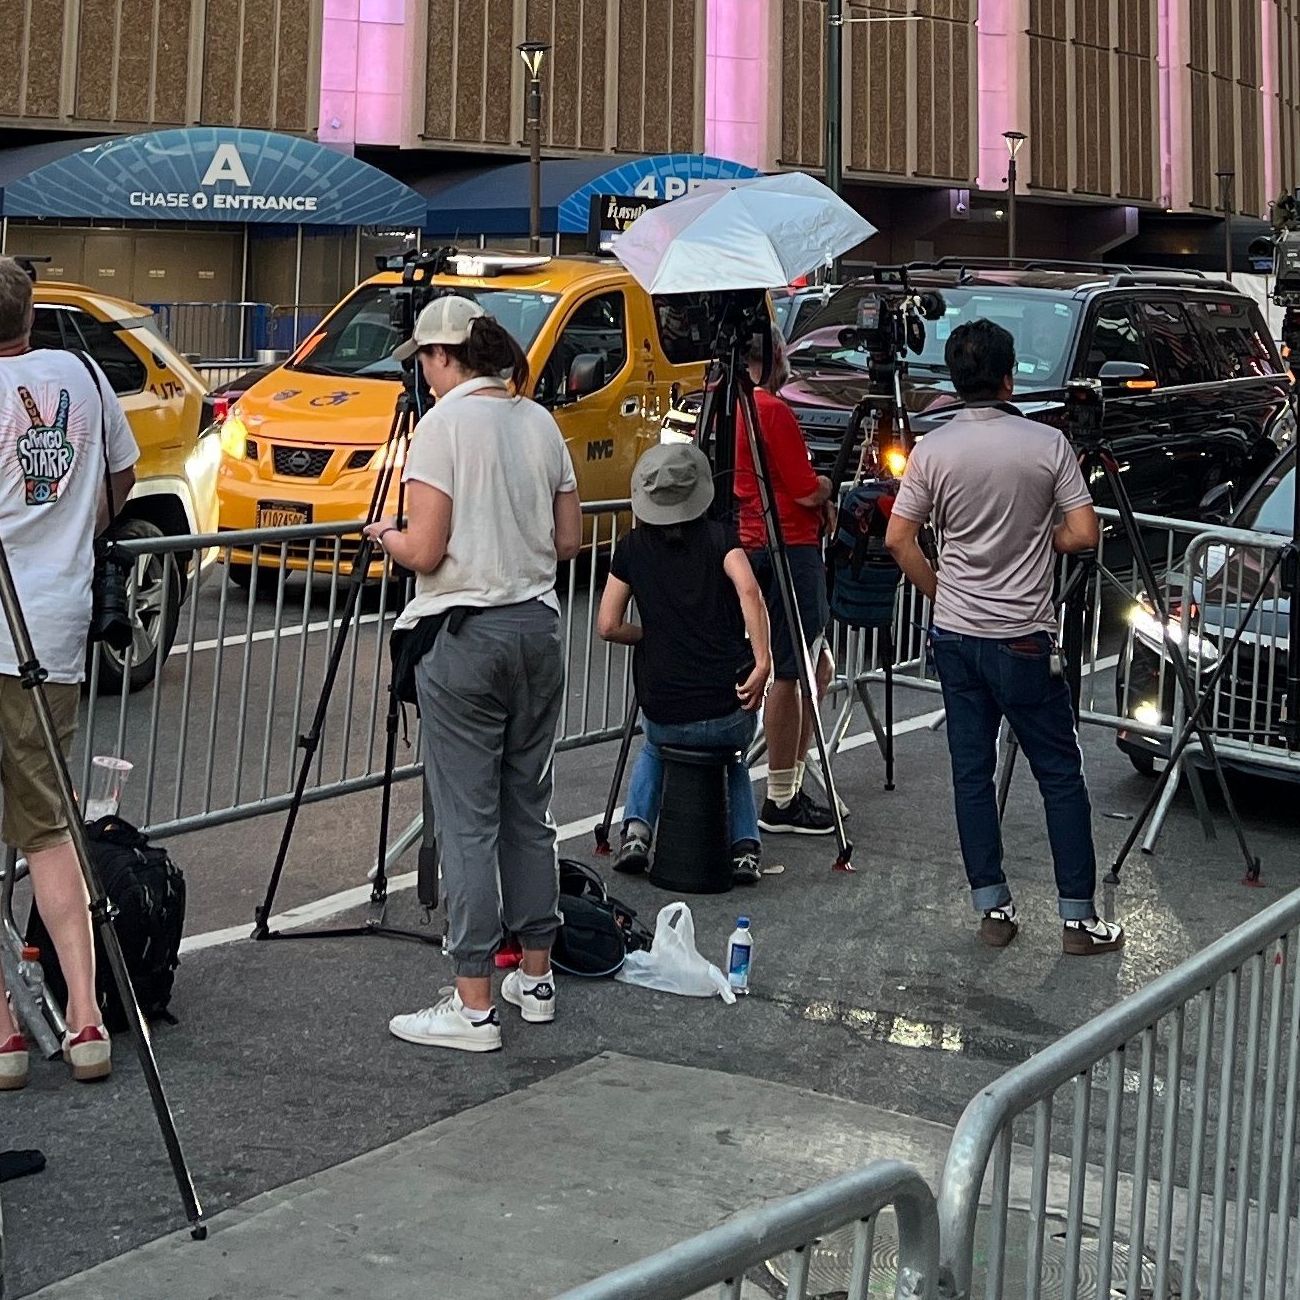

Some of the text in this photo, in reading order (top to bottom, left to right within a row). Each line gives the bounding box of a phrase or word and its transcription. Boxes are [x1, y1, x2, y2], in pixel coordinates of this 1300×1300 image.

[201, 143, 251, 187] A
[634, 175, 659, 200] 4
[129, 191, 318, 211] CHASE ENTRANCE
[27, 428, 63, 450] RINGO
[587, 439, 614, 461] NYC
[20, 438, 70, 479] STARR
